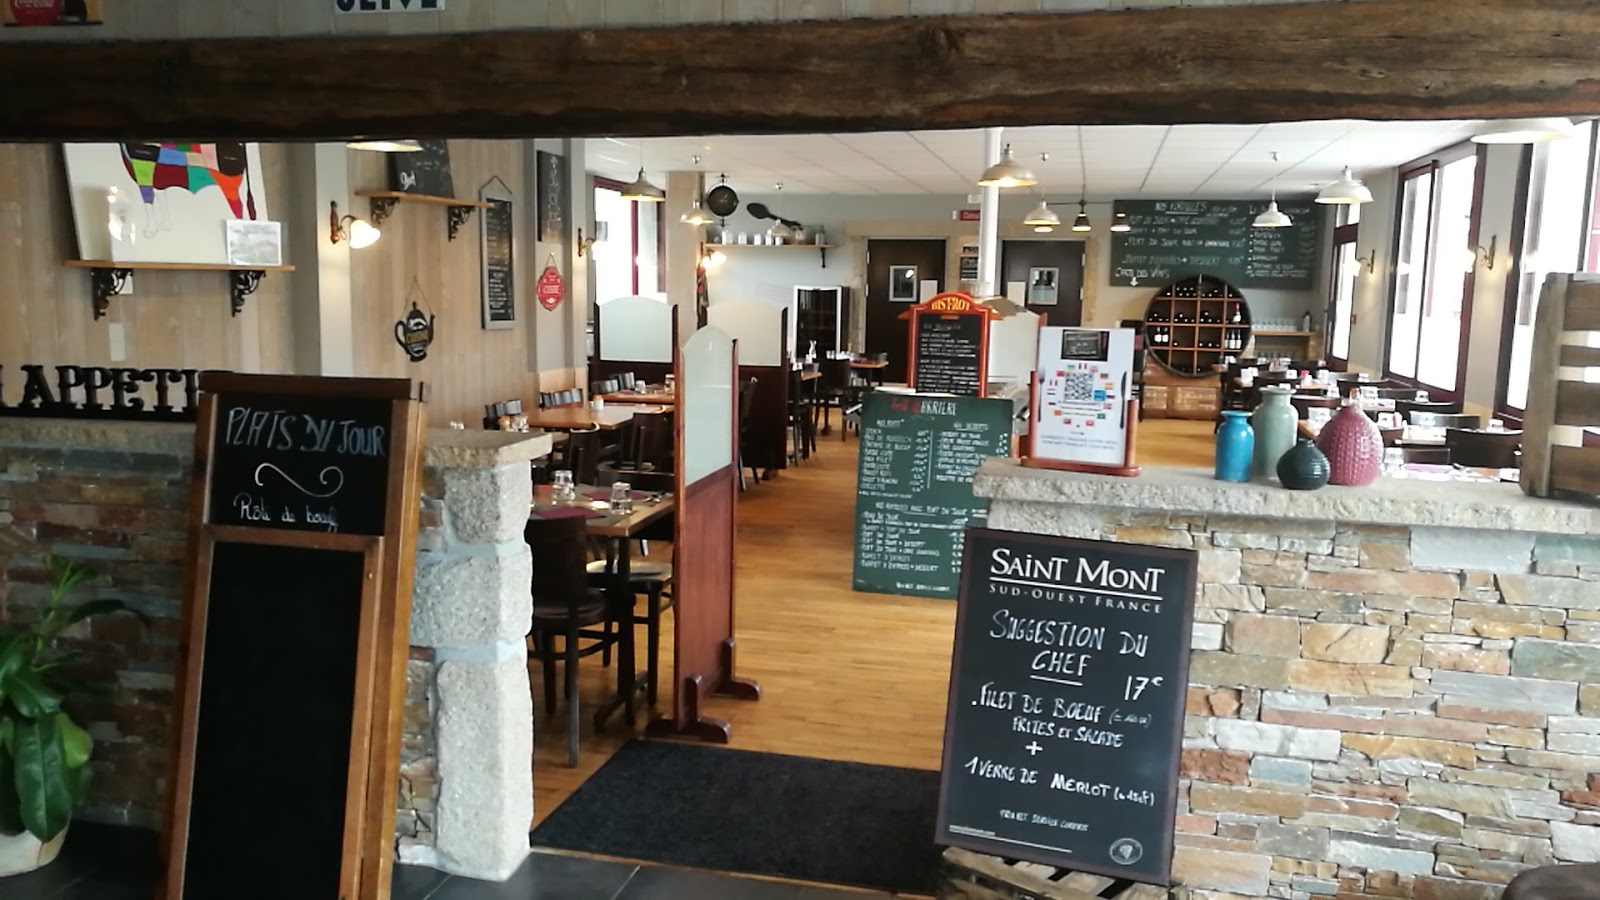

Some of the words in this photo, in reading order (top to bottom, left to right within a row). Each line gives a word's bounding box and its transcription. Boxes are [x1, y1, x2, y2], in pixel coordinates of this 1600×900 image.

[931, 297, 970, 311] BISTROT
[18, 365, 207, 414] APPETI
[226, 406, 296, 450] PLATS
[338, 420, 386, 456] JOUR
[989, 583, 1085, 604] SUD-OUEST
[1096, 596, 1161, 614] FRANCE
[989, 609, 1106, 650] SUGGESTION
[1119, 631, 1149, 657] DU
[1031, 650, 1092, 676] CHEF
[1022, 694, 1043, 714] DE
[1053, 698, 1105, 723] BOEUF
[1013, 716, 1055, 737] FRITES
[1074, 726, 1124, 748] SALADE
[1020, 768, 1038, 784] DE
[1050, 773, 1111, 798] MERLOT
